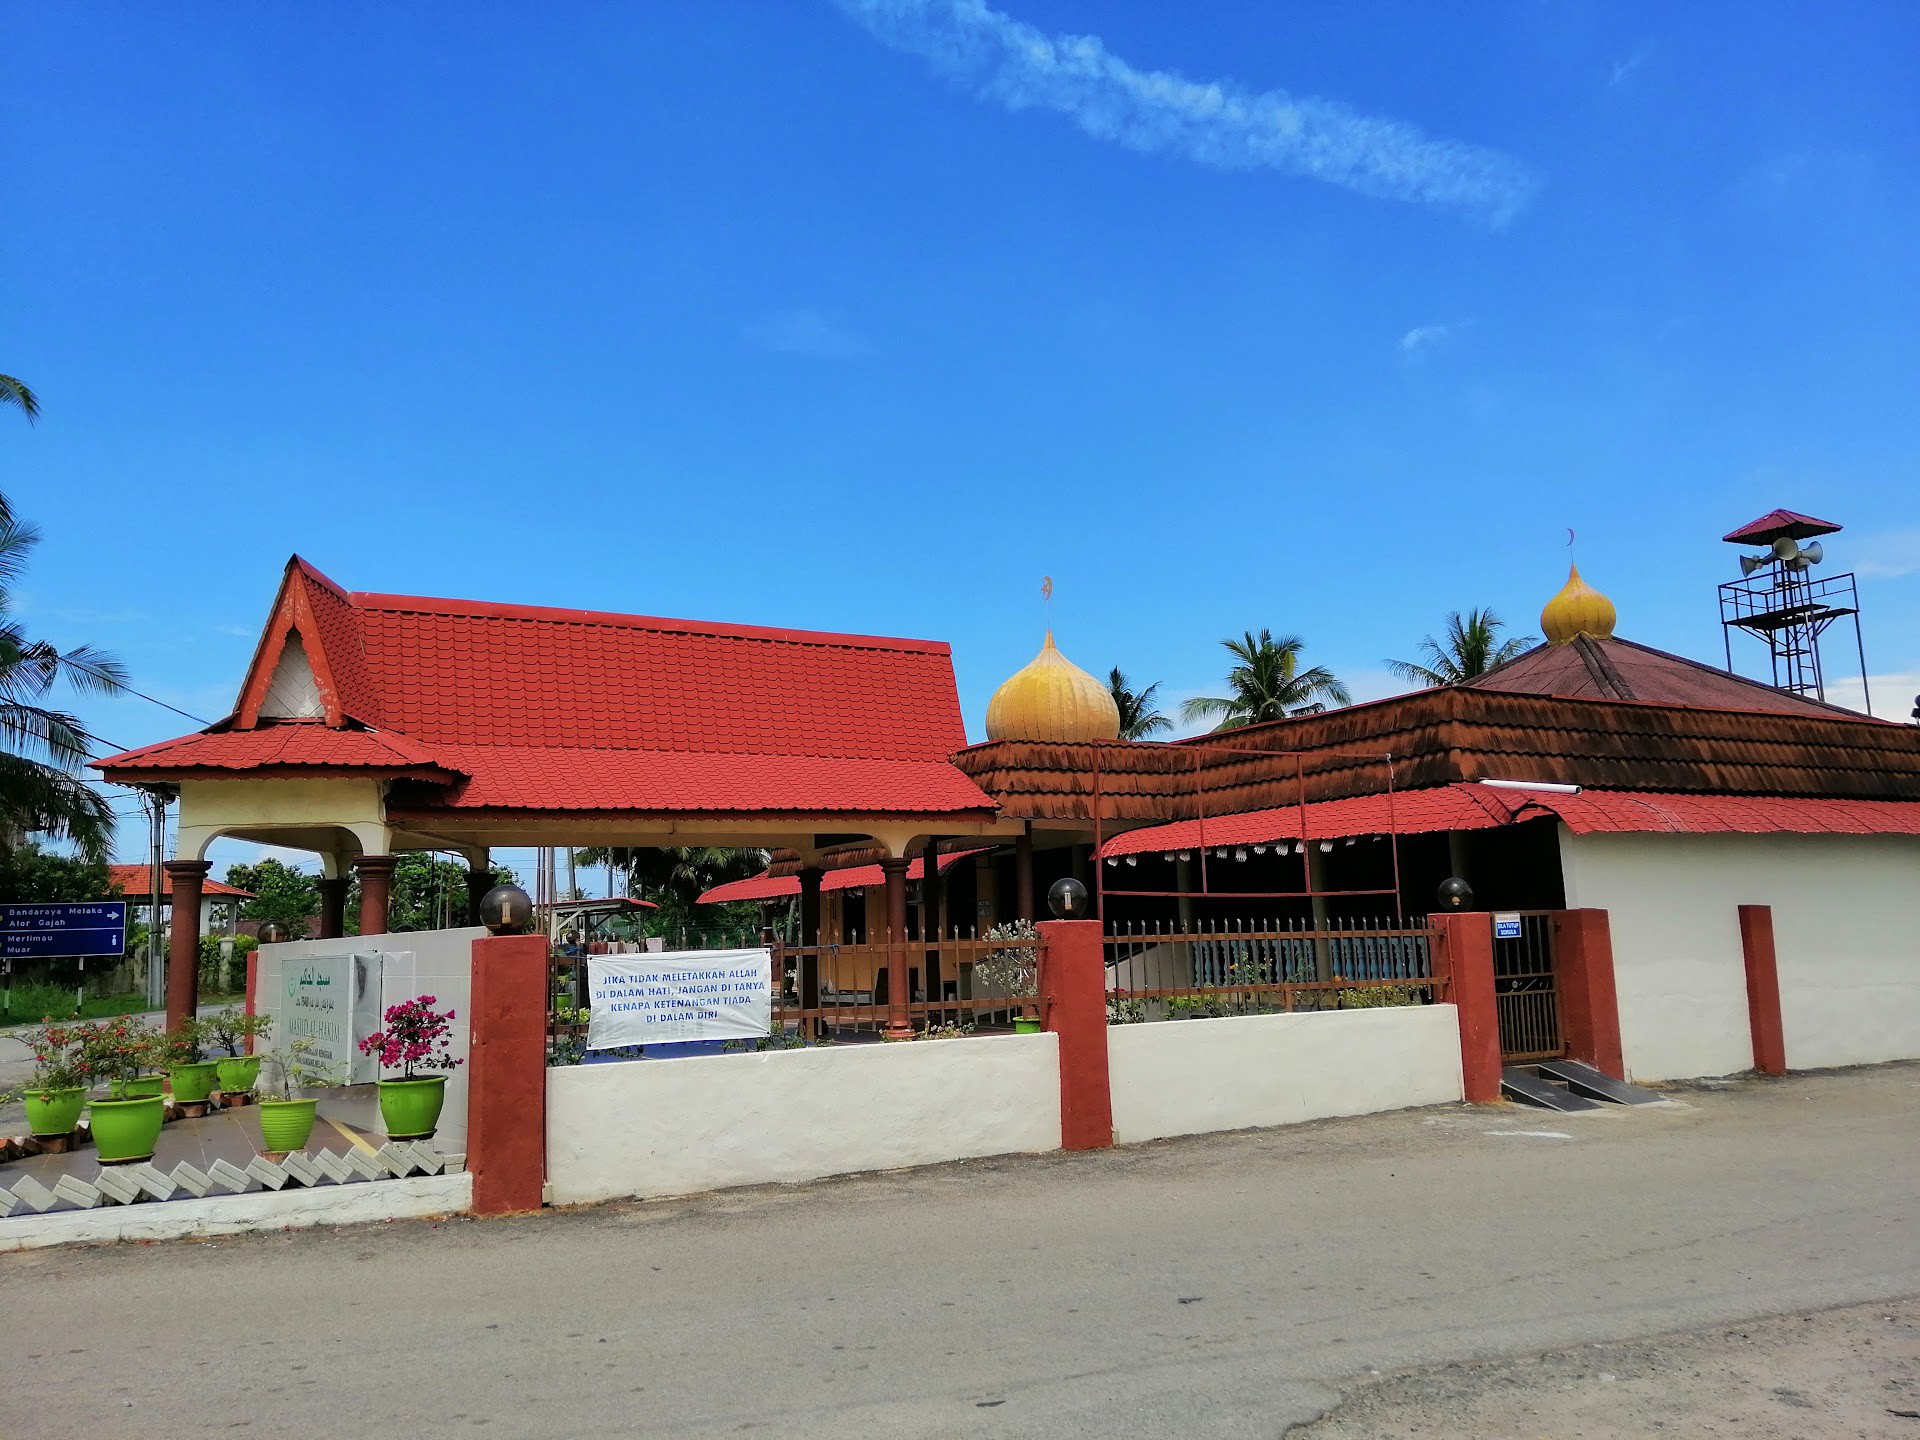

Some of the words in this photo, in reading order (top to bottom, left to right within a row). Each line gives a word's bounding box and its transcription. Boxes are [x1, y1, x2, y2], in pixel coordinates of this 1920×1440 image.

[39, 919, 65, 927] Gajah
[602, 975, 626, 985] JIKA
[628, 973, 659, 984] TIDAK
[662, 970, 726, 982] MELETAKKAN
[728, 969, 758, 979] ALLAH
[595, 990, 606, 999] DI
[609, 988, 645, 998] DALAM
[648, 987, 675, 997] HATI,
[677, 984, 718, 995] JANGAN
[721, 983, 732, 992] DI
[734, 981, 766, 991] TANYA
[610, 1001, 651, 1012] KENAPA
[654, 997, 720, 1009] KETENANGAN
[723, 995, 752, 1005] TIADA
[646, 1014, 657, 1023] DI
[660, 1012, 694, 1022] DALAM
[697, 1010, 718, 1020] DIRI
[289, 1017, 309, 1037] MASJID
[310, 1019, 341, 1043] AL-HAKIM
